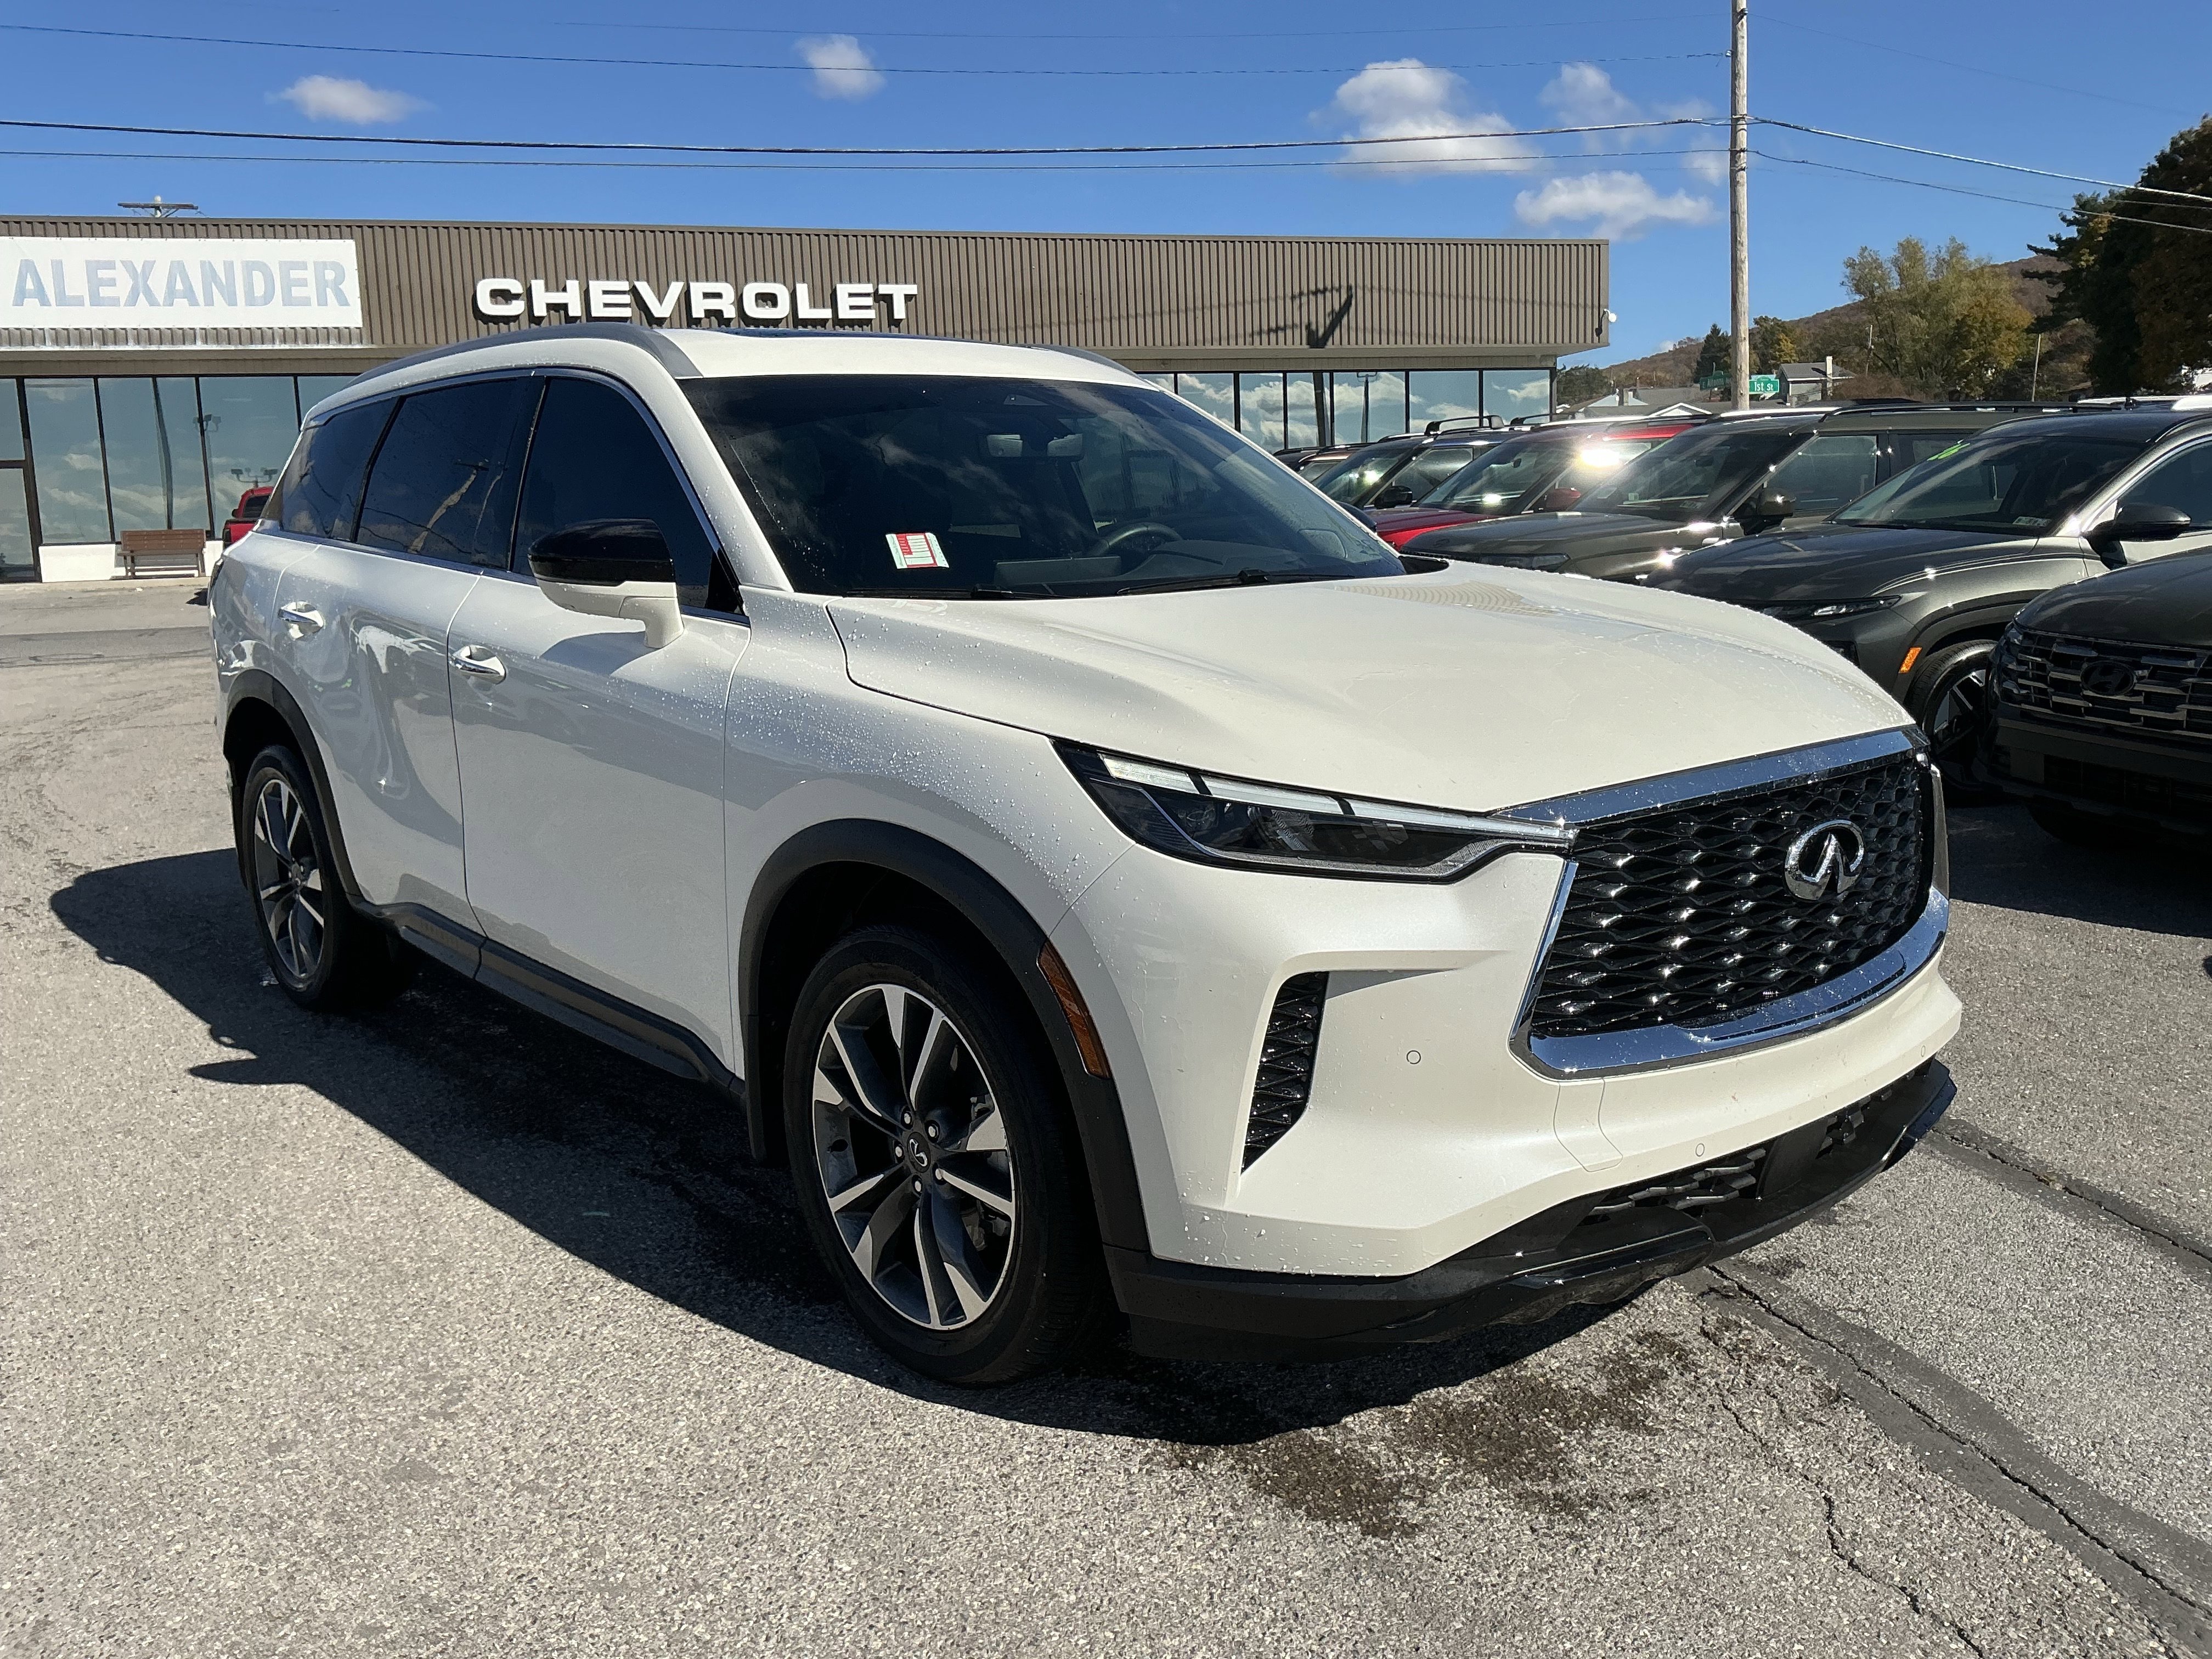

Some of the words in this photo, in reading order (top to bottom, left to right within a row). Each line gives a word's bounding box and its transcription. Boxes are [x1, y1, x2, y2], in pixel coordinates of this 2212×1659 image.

[13, 258, 351, 307] ALEXANDER
[476, 278, 918, 320] CHEVROLET
[1754, 381, 1764, 391] 1st
[1767, 382, 1773, 391] St
